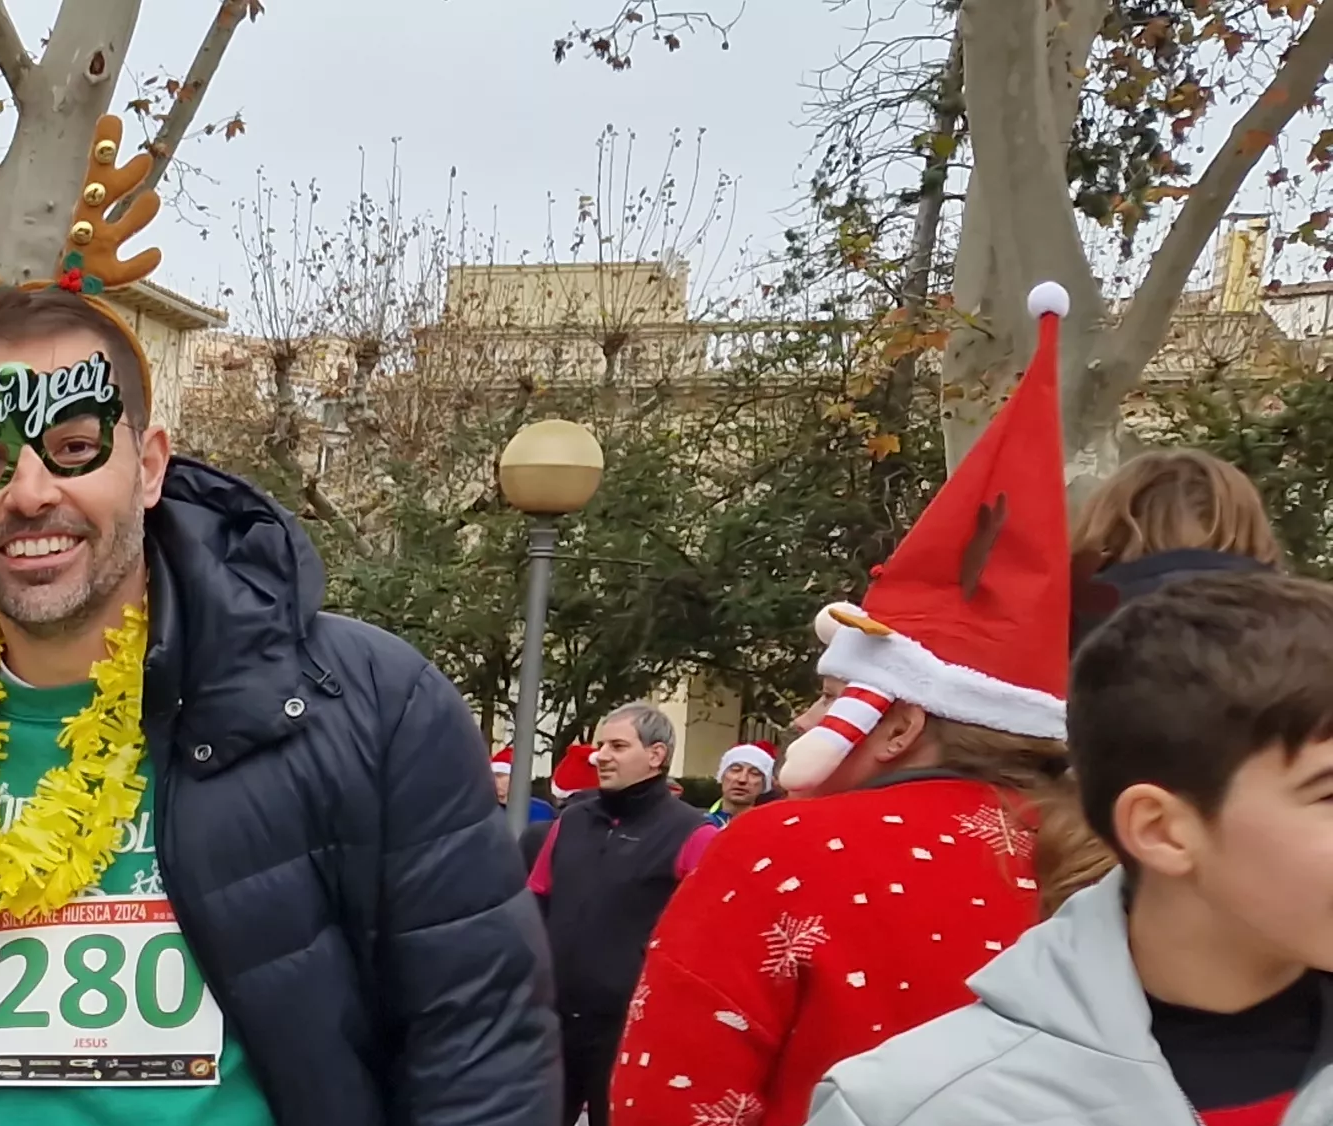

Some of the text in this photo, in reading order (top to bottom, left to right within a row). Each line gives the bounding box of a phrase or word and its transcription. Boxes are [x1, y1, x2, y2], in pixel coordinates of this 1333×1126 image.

[62, 904, 111, 922] HUESCA
[114, 903, 147, 920] 2024
[73, 1037, 108, 1048] JESUS
